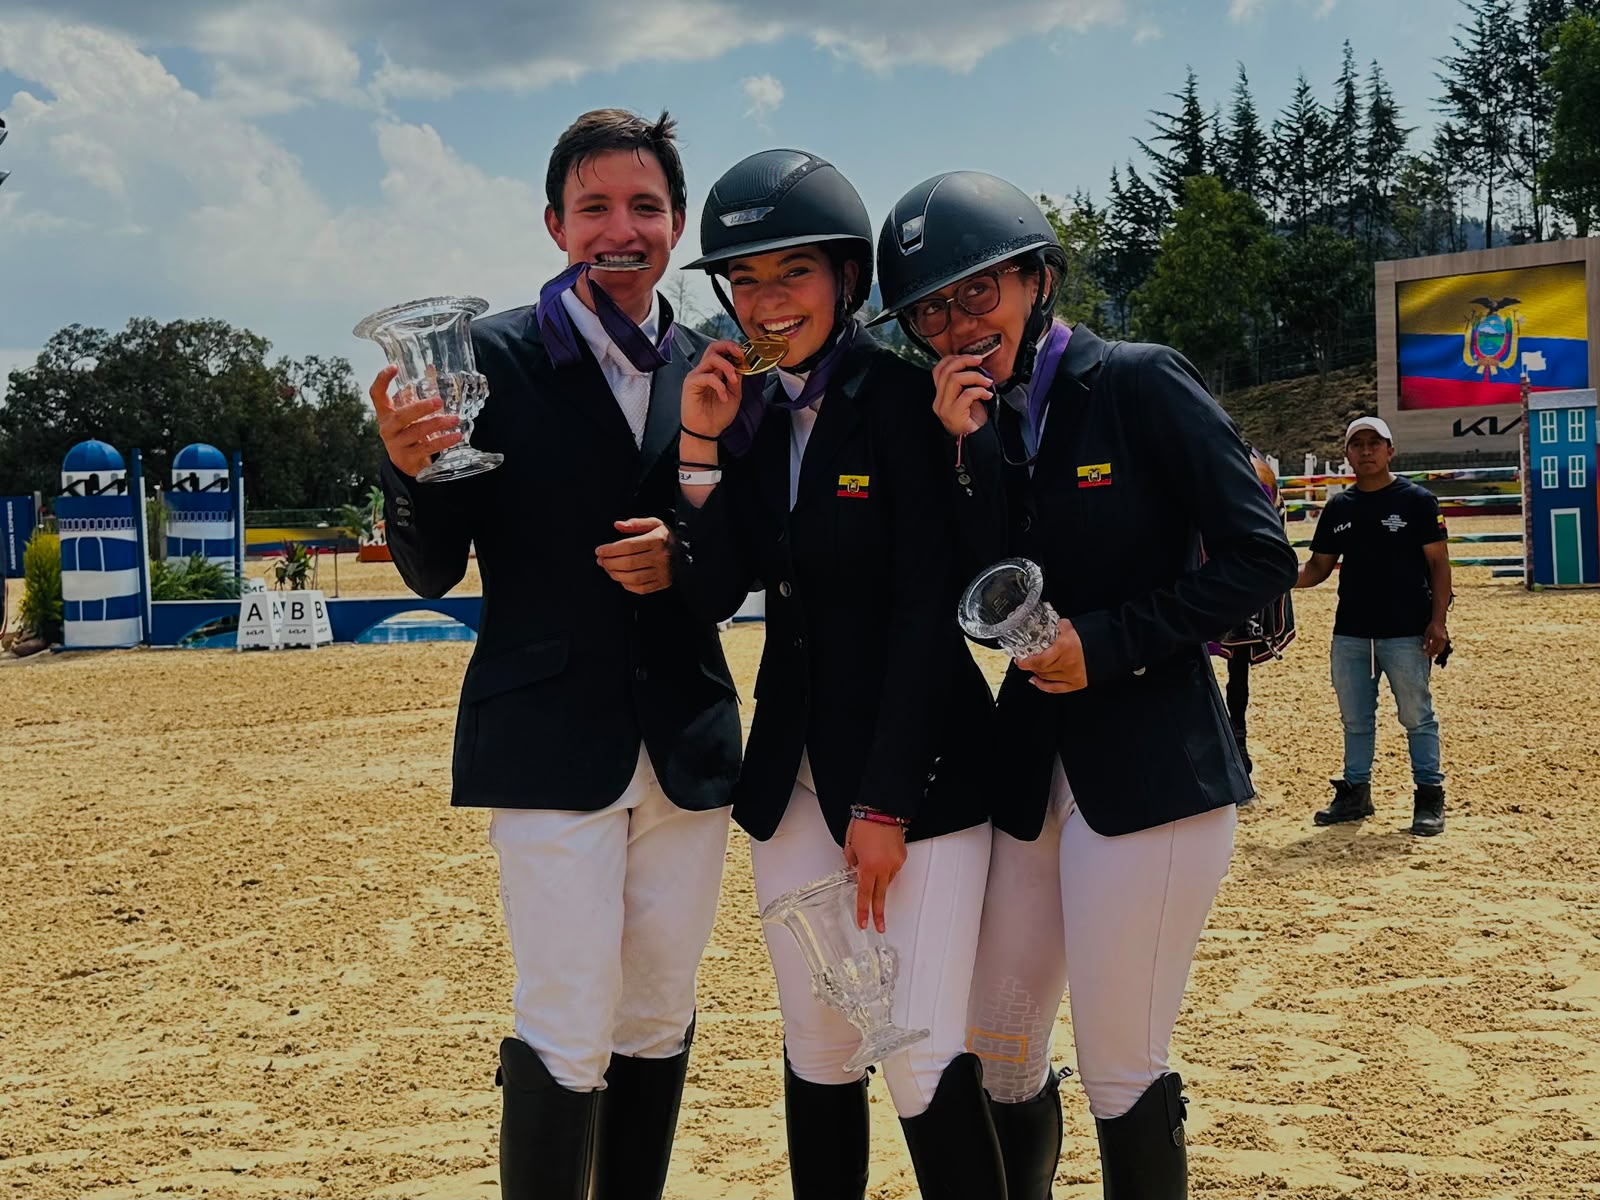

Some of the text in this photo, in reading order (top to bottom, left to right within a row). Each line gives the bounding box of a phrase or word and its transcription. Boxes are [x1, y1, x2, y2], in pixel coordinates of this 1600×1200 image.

[1333, 521, 1352, 534] KIA
[9, 533, 17, 571] AMERICAN
[246, 602, 263, 622] A
[291, 601, 304, 620] B
[314, 601, 324, 619] B
